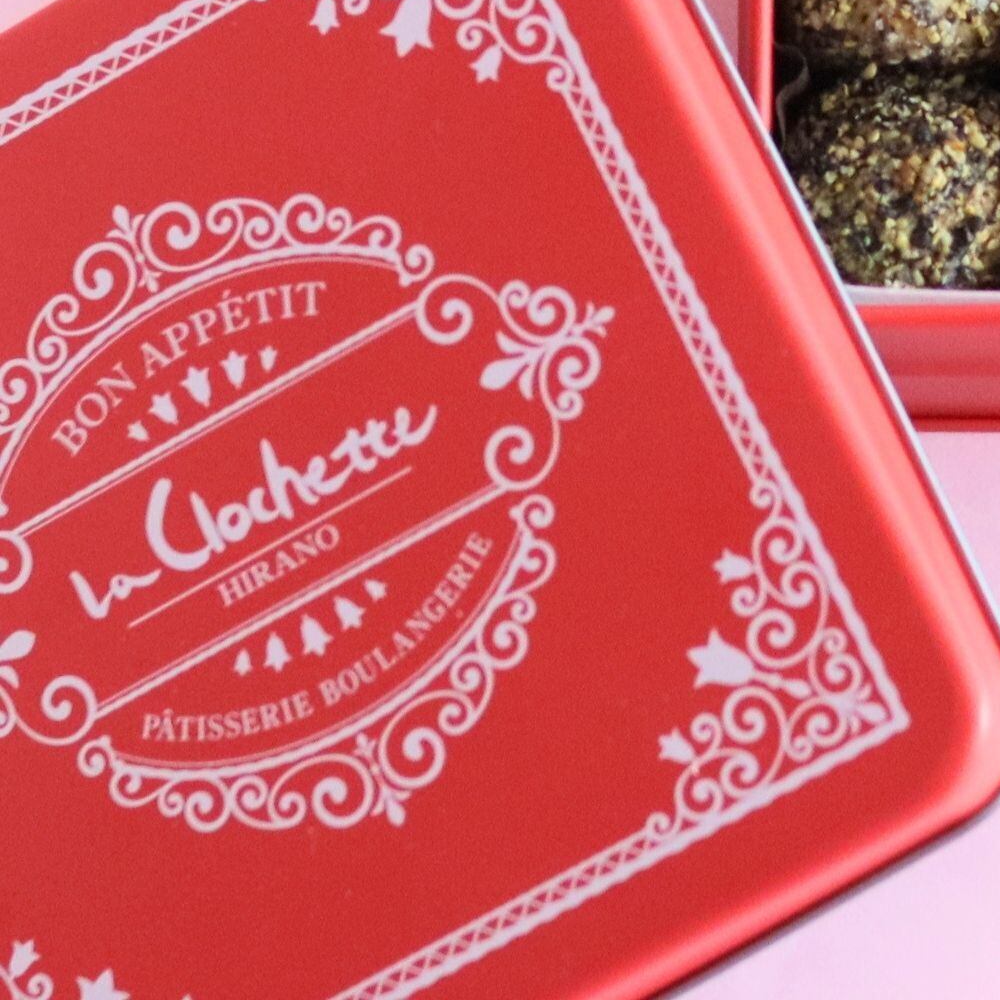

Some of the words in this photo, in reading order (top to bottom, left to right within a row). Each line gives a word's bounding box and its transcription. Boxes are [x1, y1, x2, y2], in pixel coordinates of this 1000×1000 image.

[52, 361, 136, 457] BON
[139, 281, 327, 378] APPÉTIT
[146, 404, 437, 571] Clochette
[218, 524, 340, 606] HIRANO
[142, 690, 314, 742] PÂTISSERIE
[319, 533, 493, 706] BOULANGERIE
